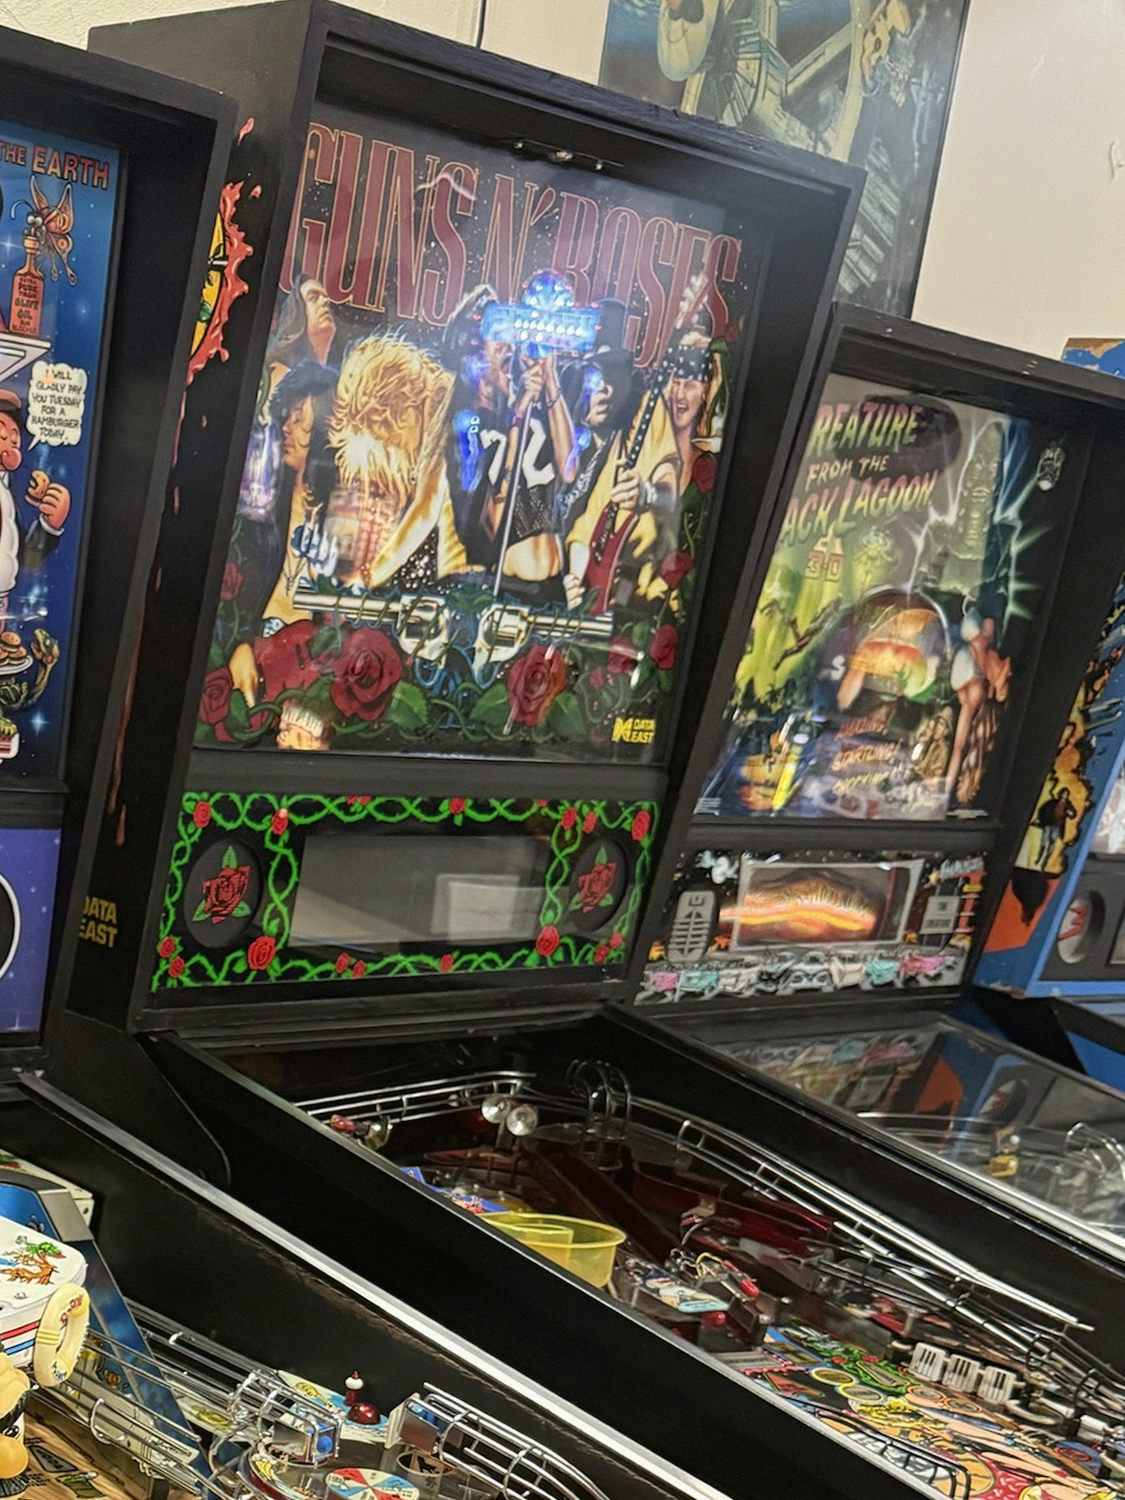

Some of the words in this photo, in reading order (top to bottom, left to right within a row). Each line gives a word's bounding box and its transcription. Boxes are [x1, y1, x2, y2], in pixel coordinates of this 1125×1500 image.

[32, 145, 111, 191] EARTH
[279, 121, 480, 327] GUNS
[554, 190, 744, 369] ROSES
[17, 309, 33, 321] OIL
[67, 384, 83, 395] PAY
[31, 392, 48, 404] YOU
[49, 394, 82, 408] TUESDAY
[41, 405, 56, 415] FOR
[58, 407, 66, 416] A
[31, 415, 80, 429] HAMBURGER
[806, 400, 924, 457] REATURE
[806, 458, 853, 491] FROM
[859, 454, 890, 477] THE
[780, 486, 840, 547] ACK
[835, 468, 940, 537] LAGOON
[633, 718, 655, 731] DATA
[631, 730, 654, 744] EAST
